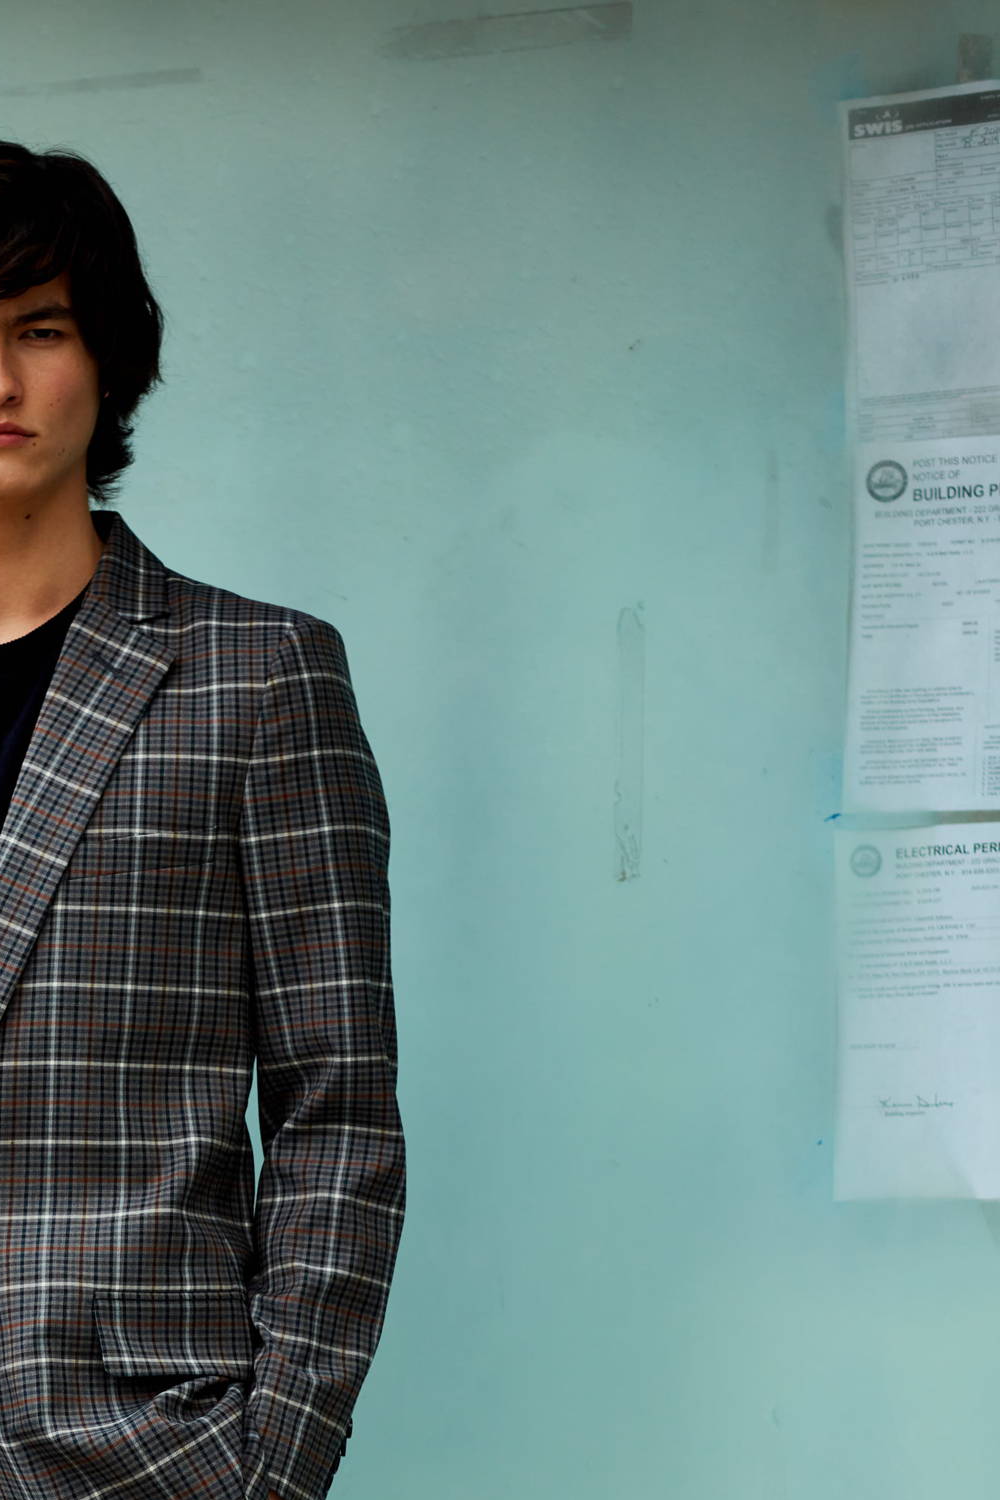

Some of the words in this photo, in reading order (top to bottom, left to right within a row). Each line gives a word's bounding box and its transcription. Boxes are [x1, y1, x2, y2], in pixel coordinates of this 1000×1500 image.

[853, 120, 902, 137] SWIS
[913, 457, 936, 468] POST
[939, 456, 960, 466] THIS
[962, 454, 997, 465] NOTICE
[913, 471, 945, 481] NOTICE
[948, 469, 960, 480] OF
[912, 484, 985, 502] BUILDING
[989, 483, 1000, 497] P
[915, 506, 967, 518] DEPARTMENT
[895, 844, 969, 859] ELECTRICAL
